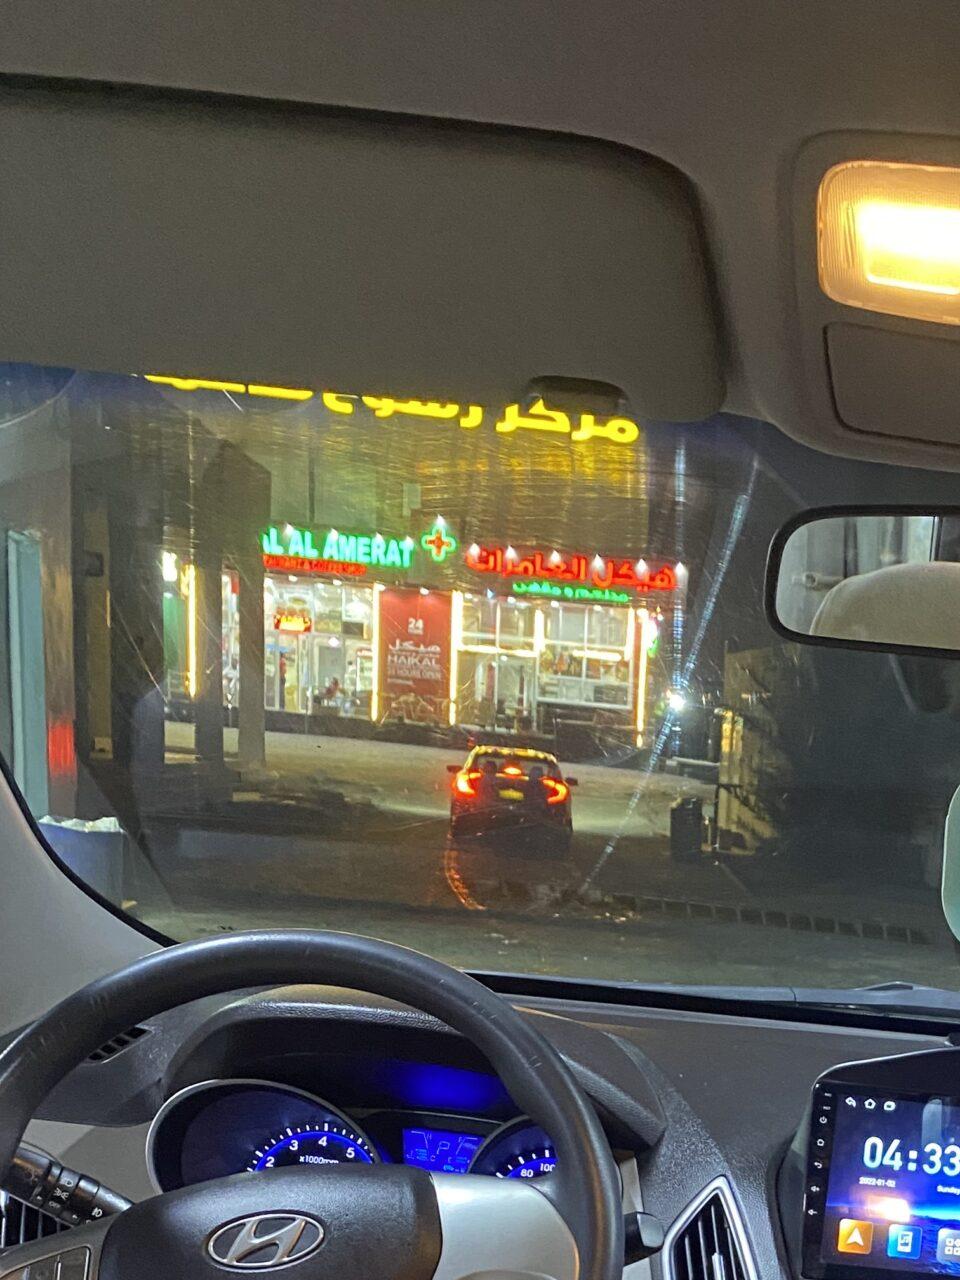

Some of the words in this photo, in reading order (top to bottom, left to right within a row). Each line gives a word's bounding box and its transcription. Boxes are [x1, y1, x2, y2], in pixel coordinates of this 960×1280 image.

[288, 529, 319, 558] AL
[323, 533, 414, 567] AMERAT
[591, 558, 679, 592] هيكل
[407, 617, 424, 629] 24
[387, 654, 438, 667] HAIKAL
[289, 1139, 299, 1151] 3
[318, 1136, 328, 1147] 4
[436, 1140, 450, 1155] P
[345, 1147, 355, 1159] 5
[265, 1156, 275, 1168] 2
[520, 1169, 534, 1178] 80
[859, 1176, 896, 1188] 2022-01-02
